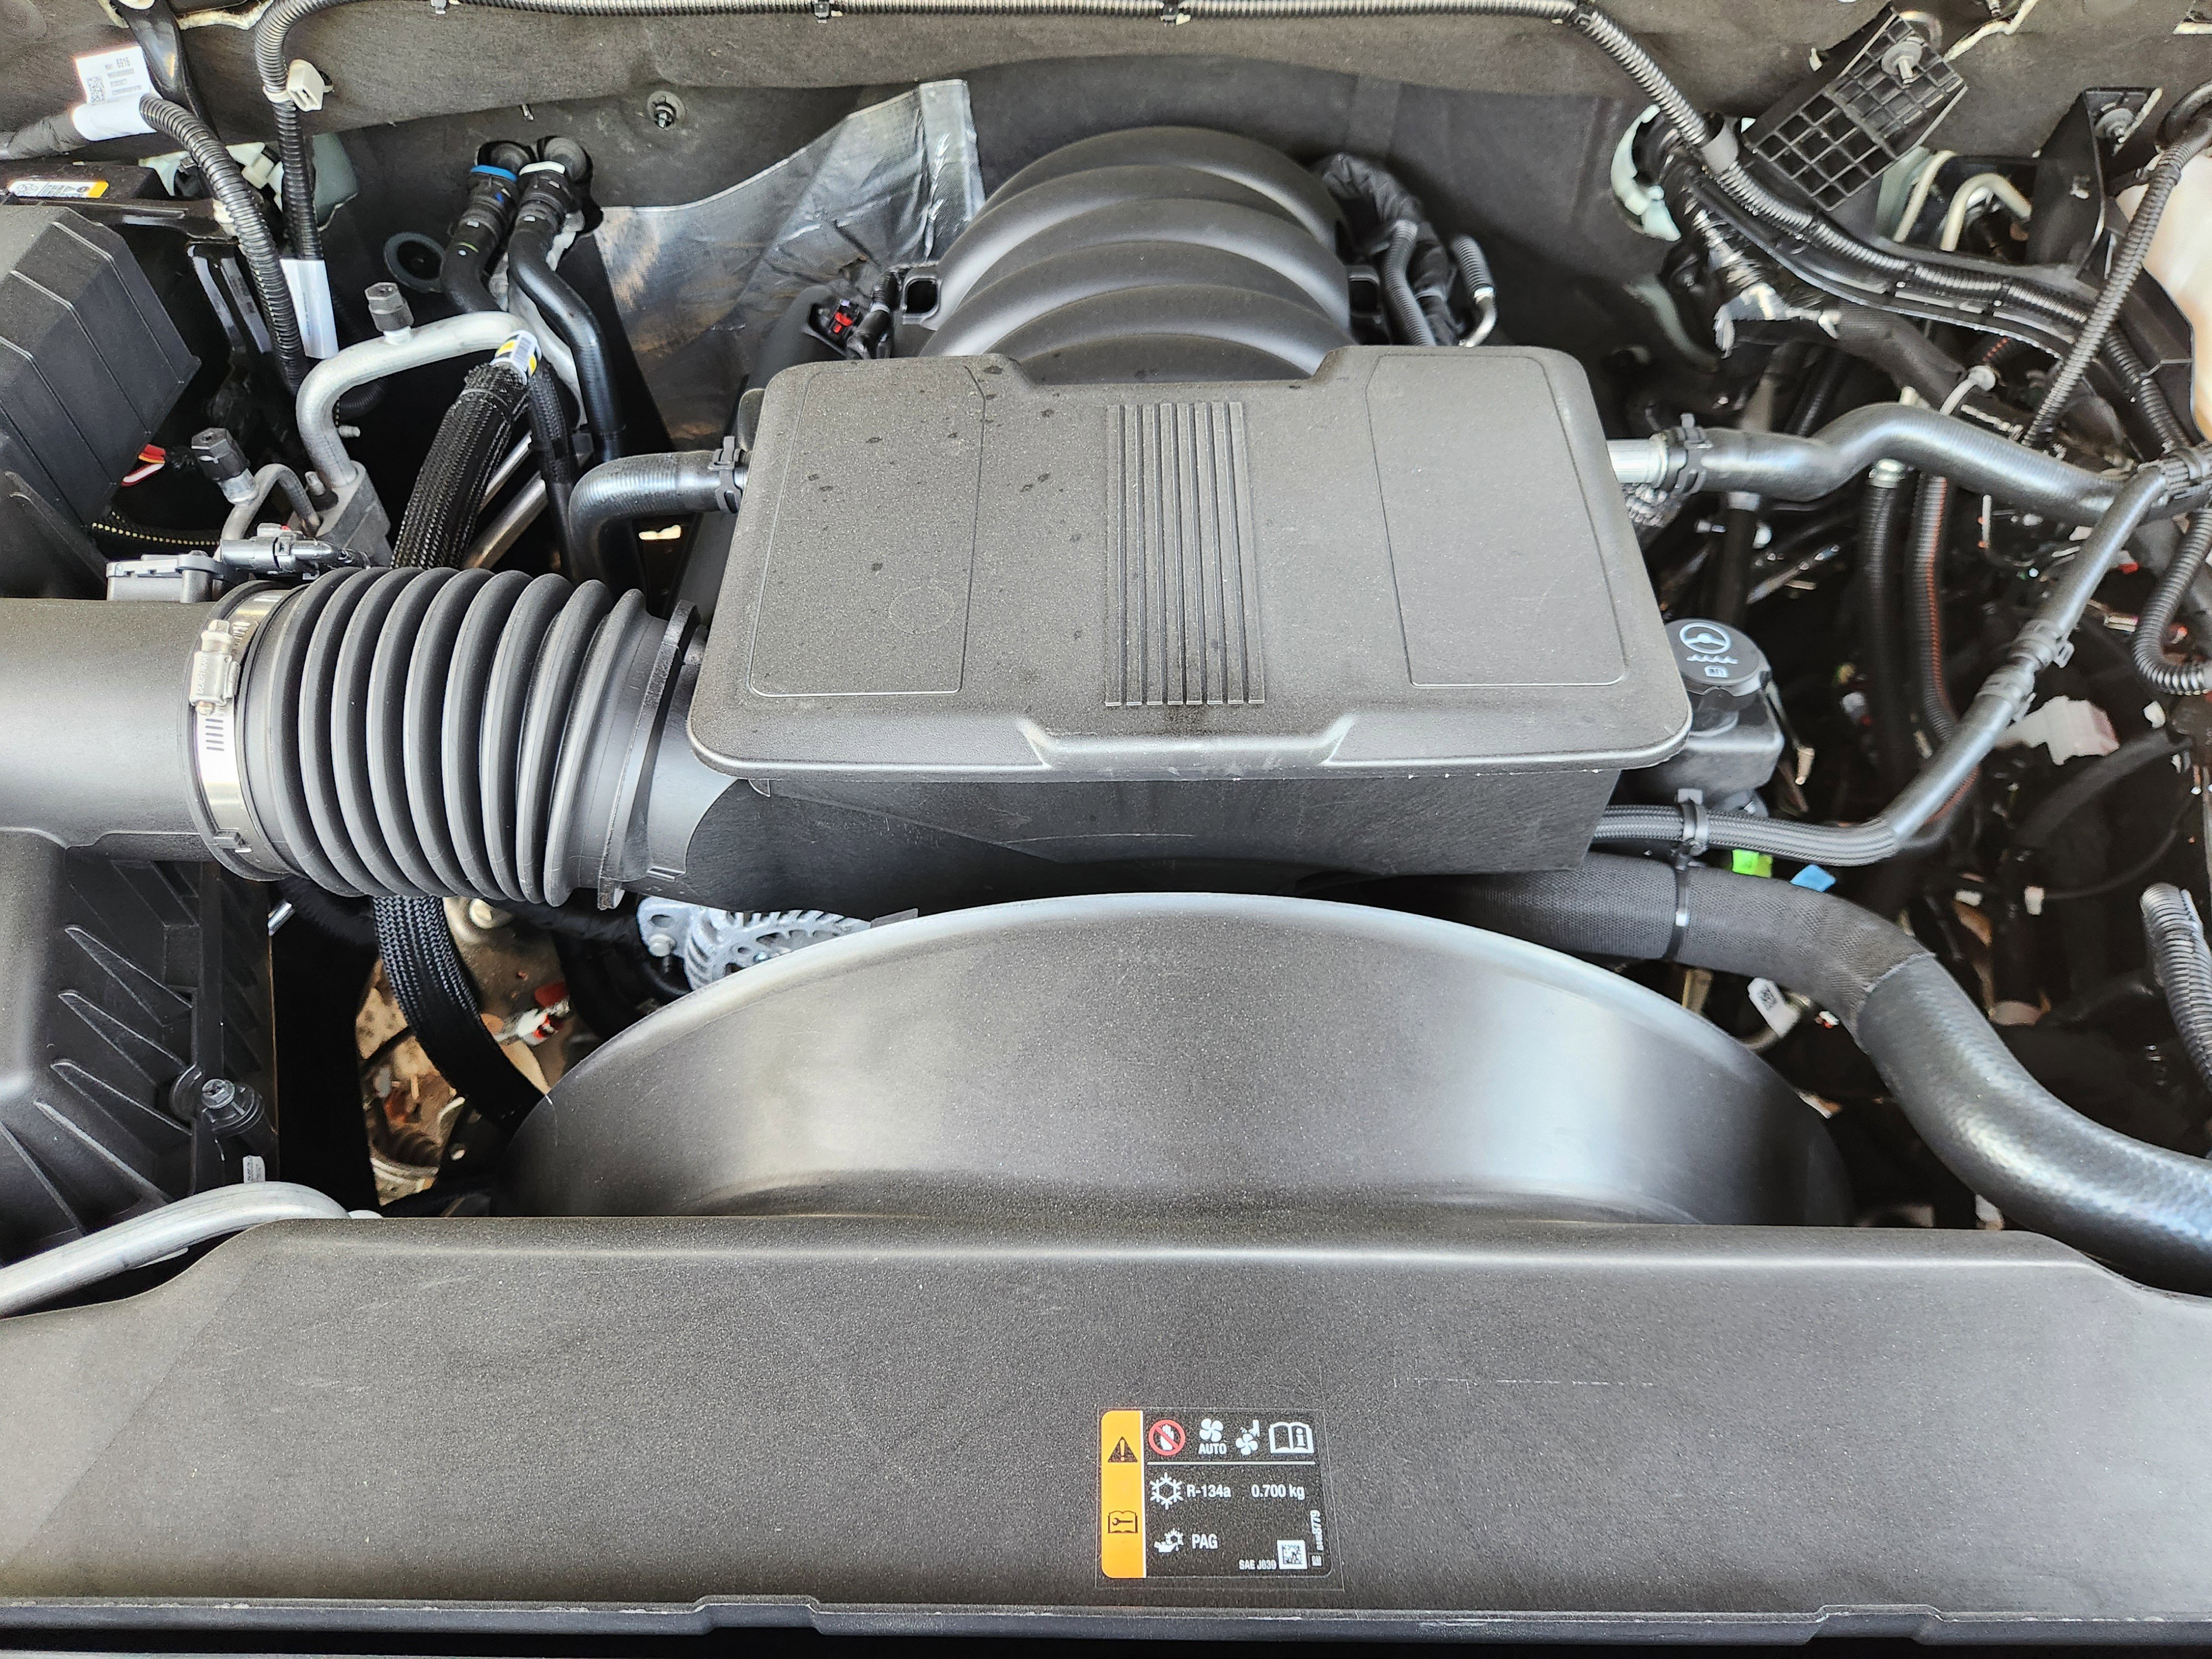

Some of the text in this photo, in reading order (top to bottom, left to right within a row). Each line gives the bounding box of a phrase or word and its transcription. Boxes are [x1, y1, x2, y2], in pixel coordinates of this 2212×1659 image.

[1198, 1443, 1227, 1455] AUTO
[1187, 1484, 1305, 1500] R-134a 0.700 kg
[1191, 1533, 1218, 1550] PAG
[1239, 1559, 1255, 1570] SAE
